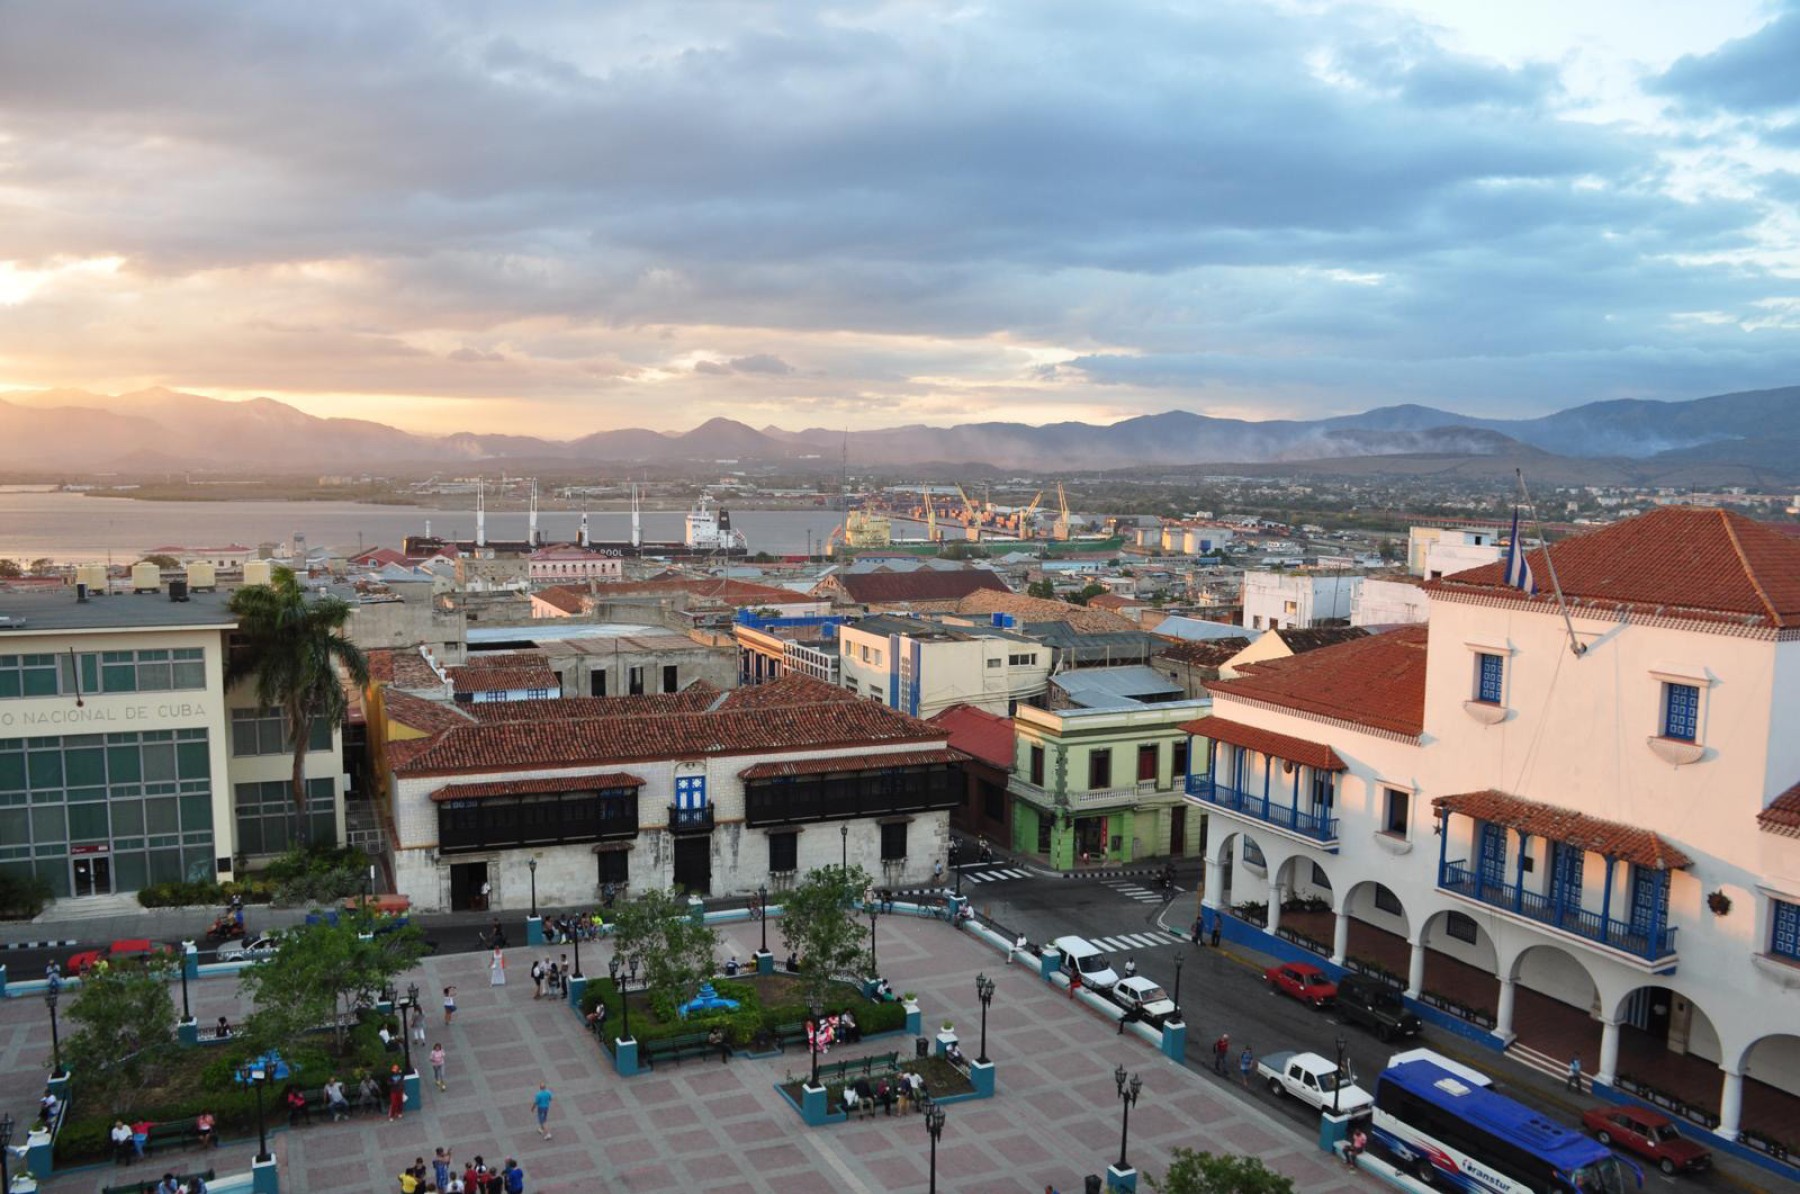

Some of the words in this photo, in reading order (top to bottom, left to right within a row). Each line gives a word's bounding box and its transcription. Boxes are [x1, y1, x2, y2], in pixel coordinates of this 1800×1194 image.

[24, 708, 117, 725] NACIONAL
[125, 706, 149, 720] DE
[157, 704, 206, 718] CUBA
